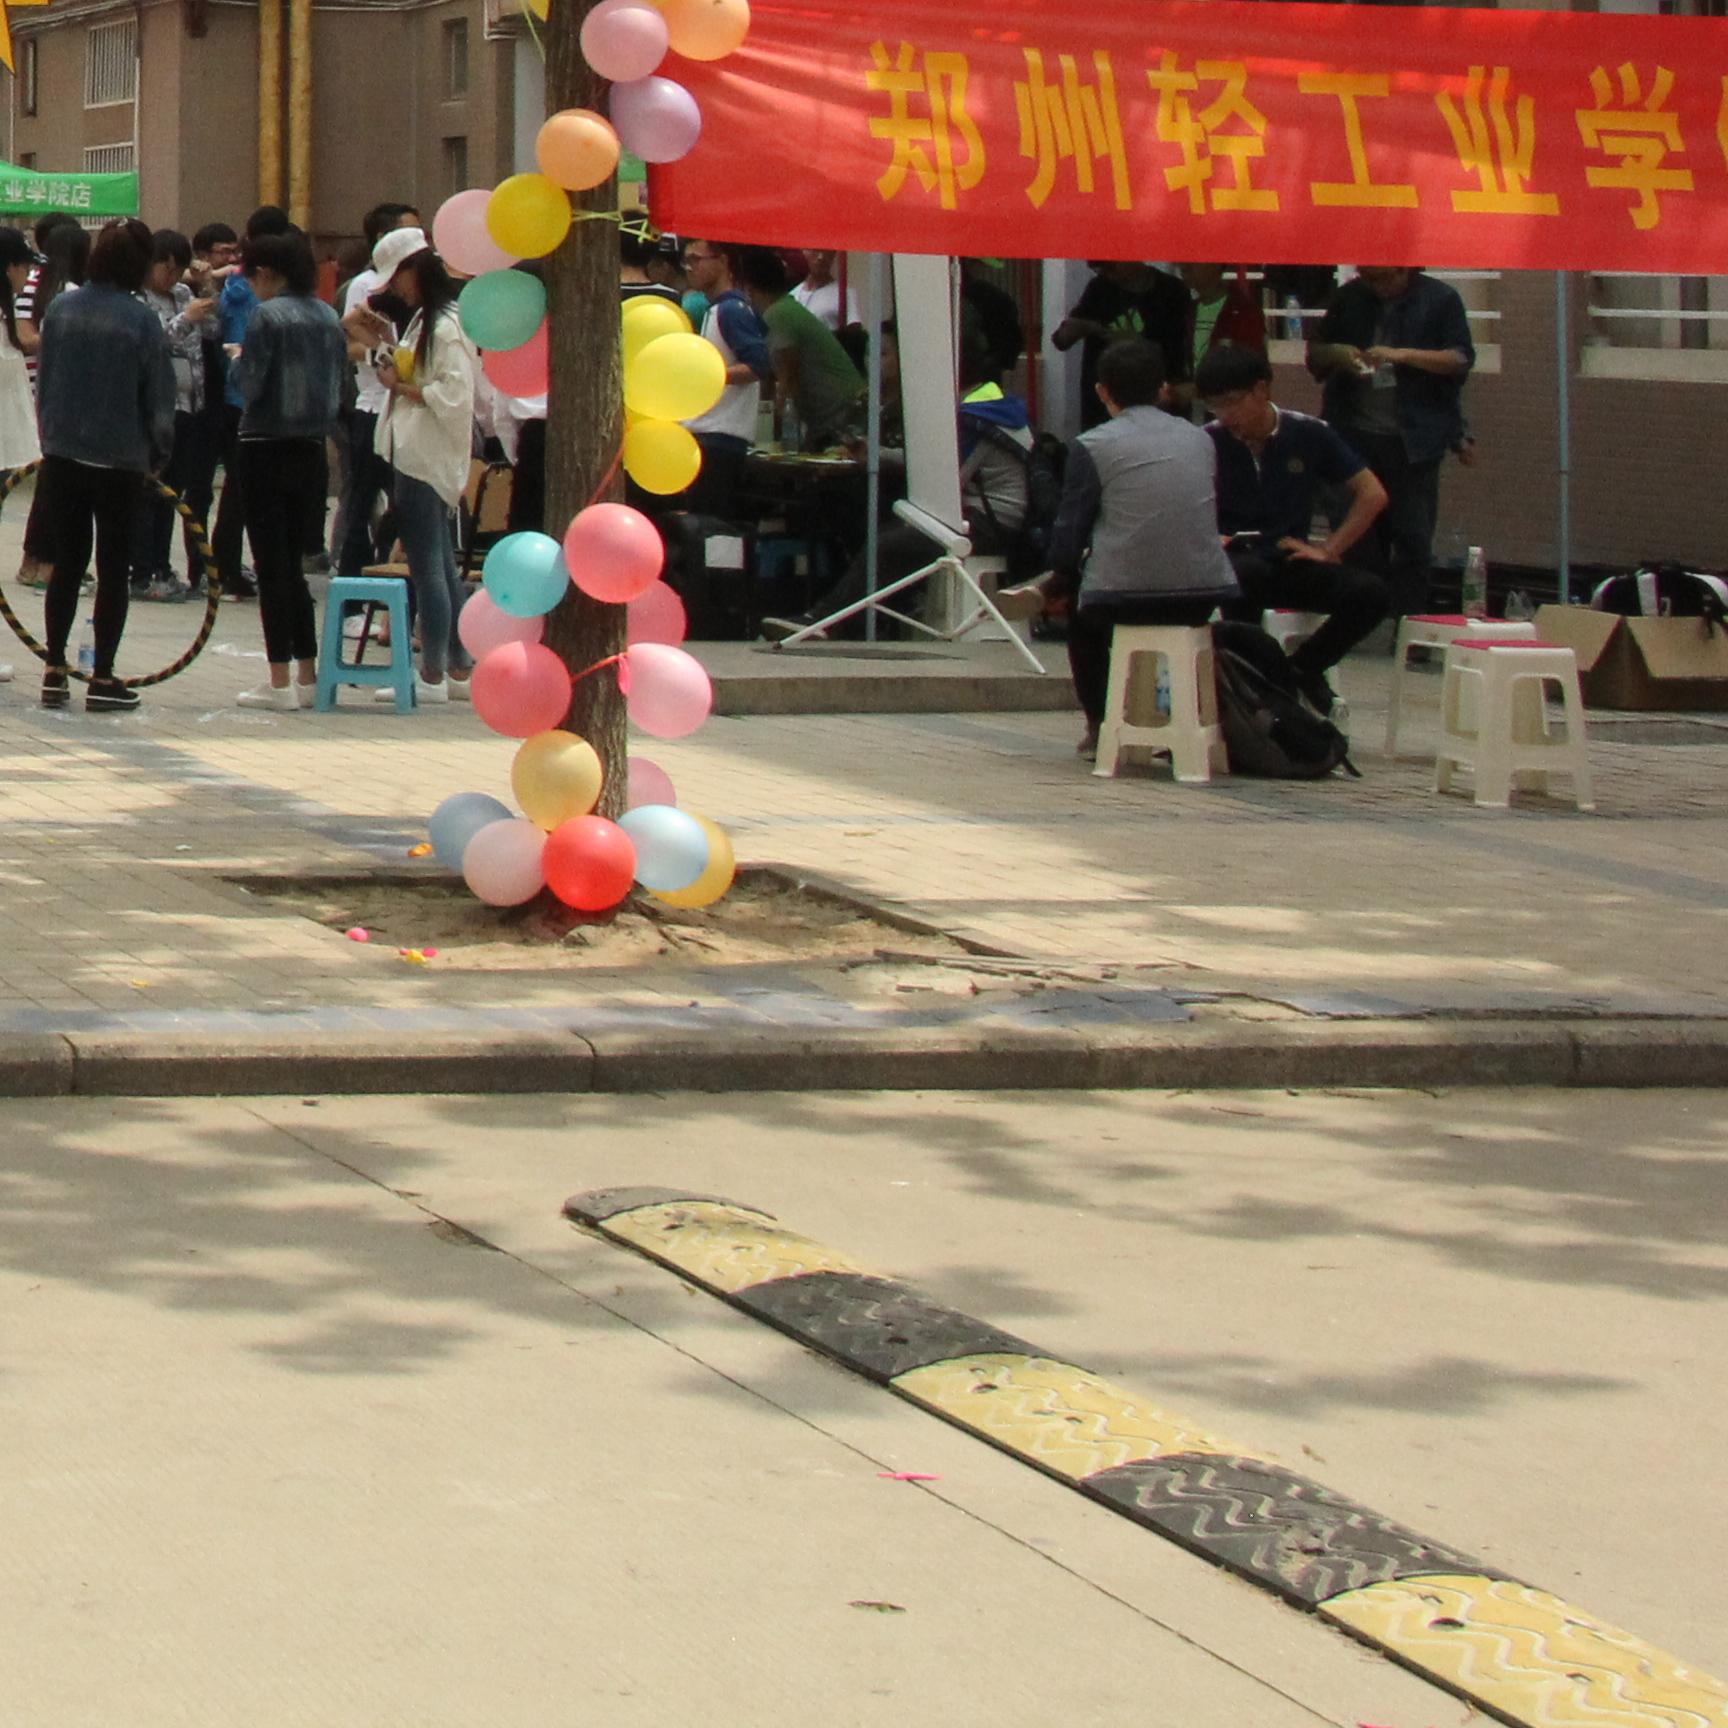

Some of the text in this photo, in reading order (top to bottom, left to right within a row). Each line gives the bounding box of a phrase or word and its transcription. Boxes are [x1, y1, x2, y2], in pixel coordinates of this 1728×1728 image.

[865, 40, 1728, 231] 郑州轻工业学
